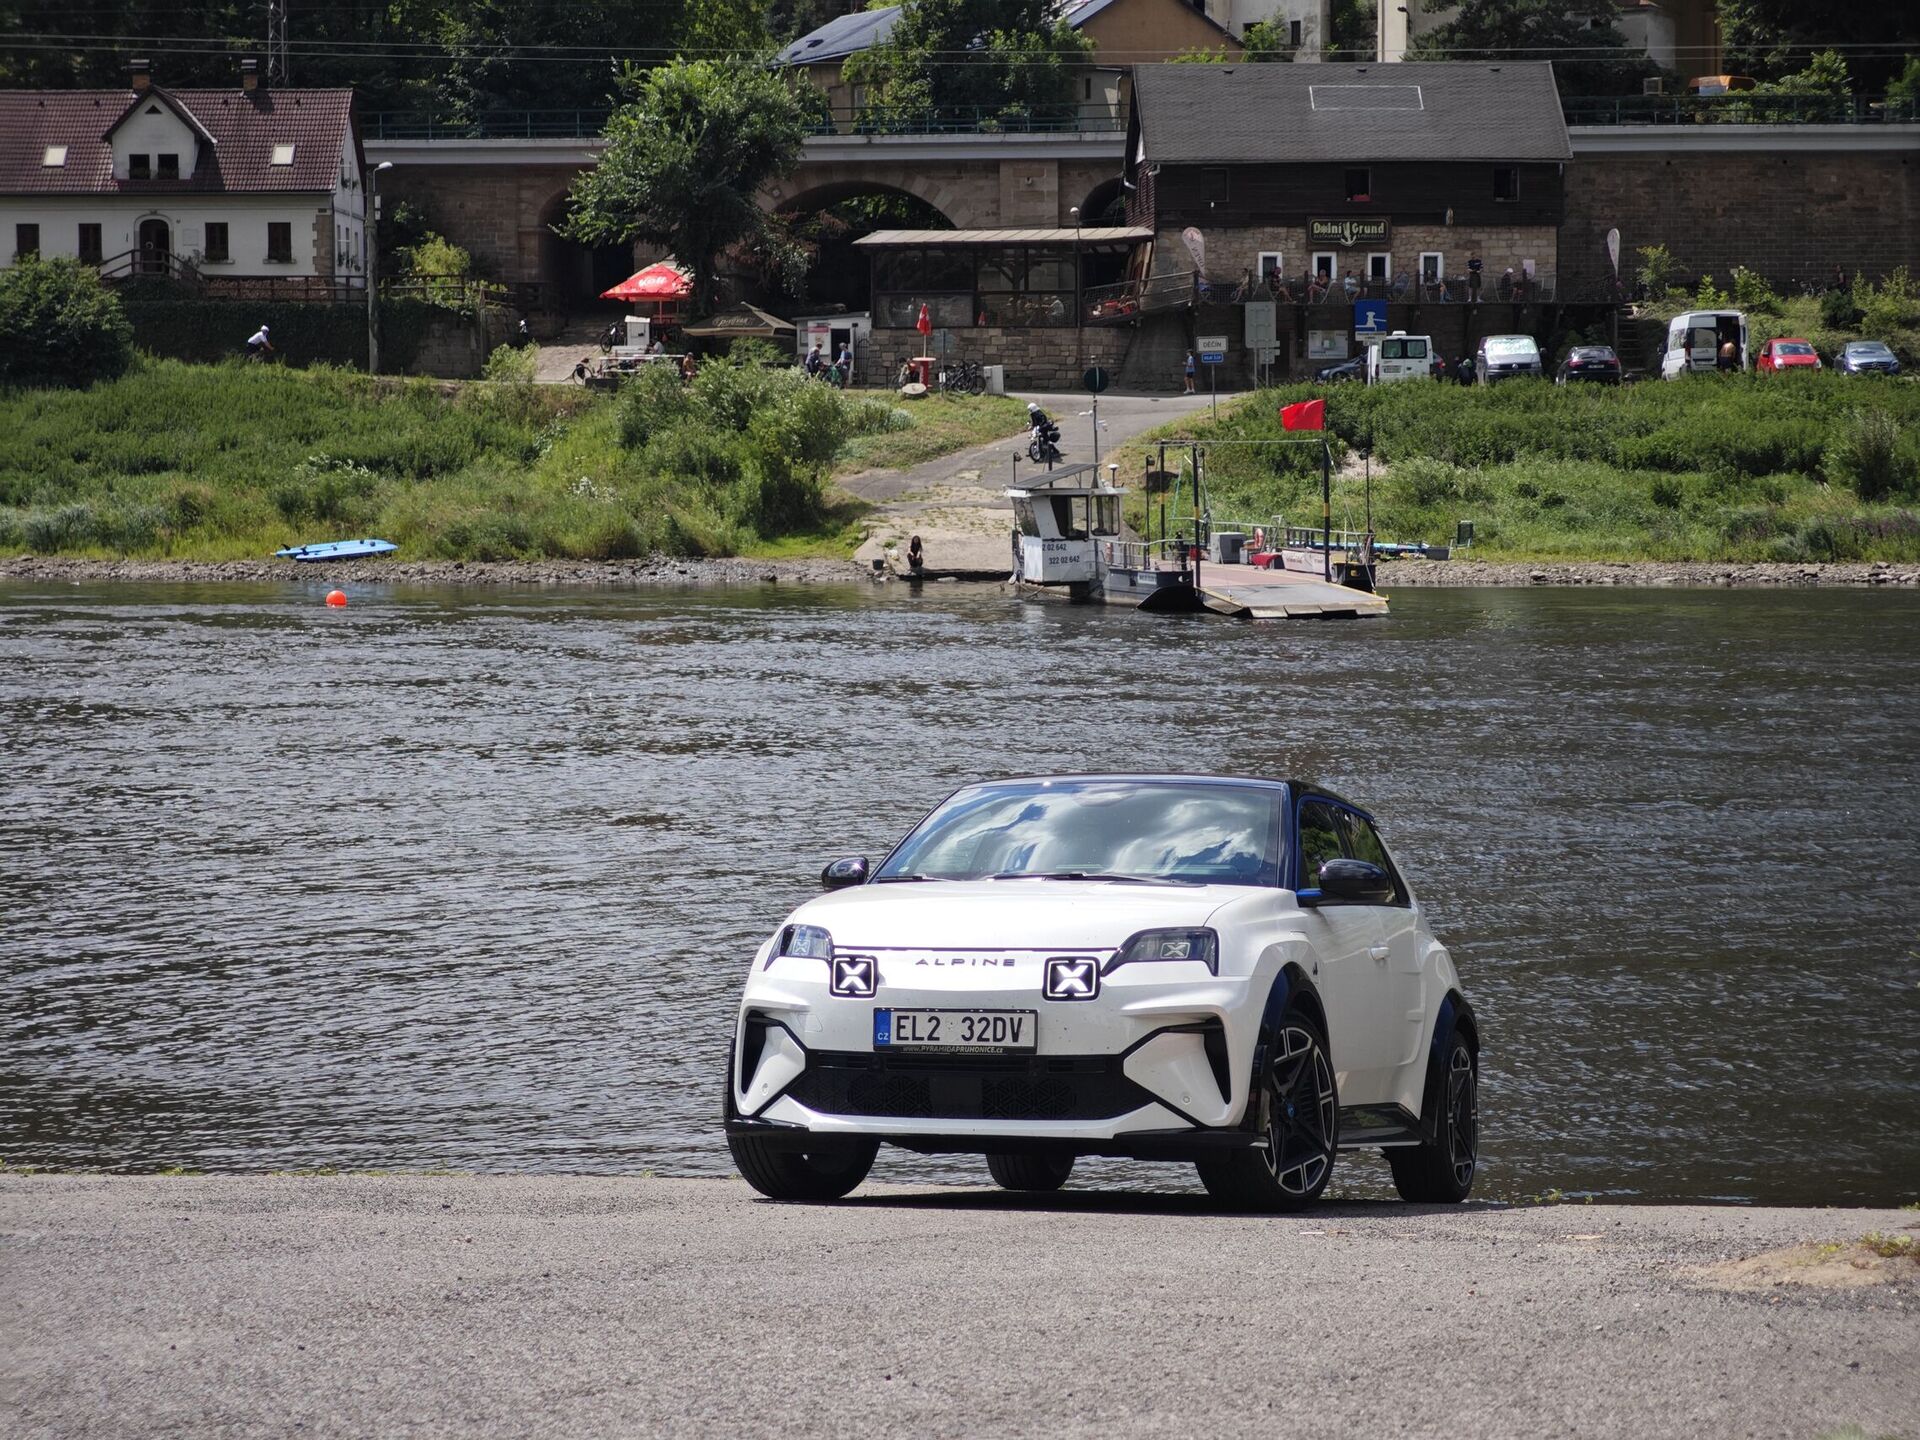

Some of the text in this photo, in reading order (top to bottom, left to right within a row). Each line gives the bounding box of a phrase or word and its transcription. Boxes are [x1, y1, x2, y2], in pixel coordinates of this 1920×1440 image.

[1352, 222, 1385, 234] Grund
[1056, 543, 1067, 551] 642
[1061, 556, 1069, 564] 02
[1069, 555, 1080, 563] 642
[915, 958, 1016, 967] ALPINE
[896, 1015, 941, 1042] EL2
[961, 1016, 1023, 1043] 32DV
